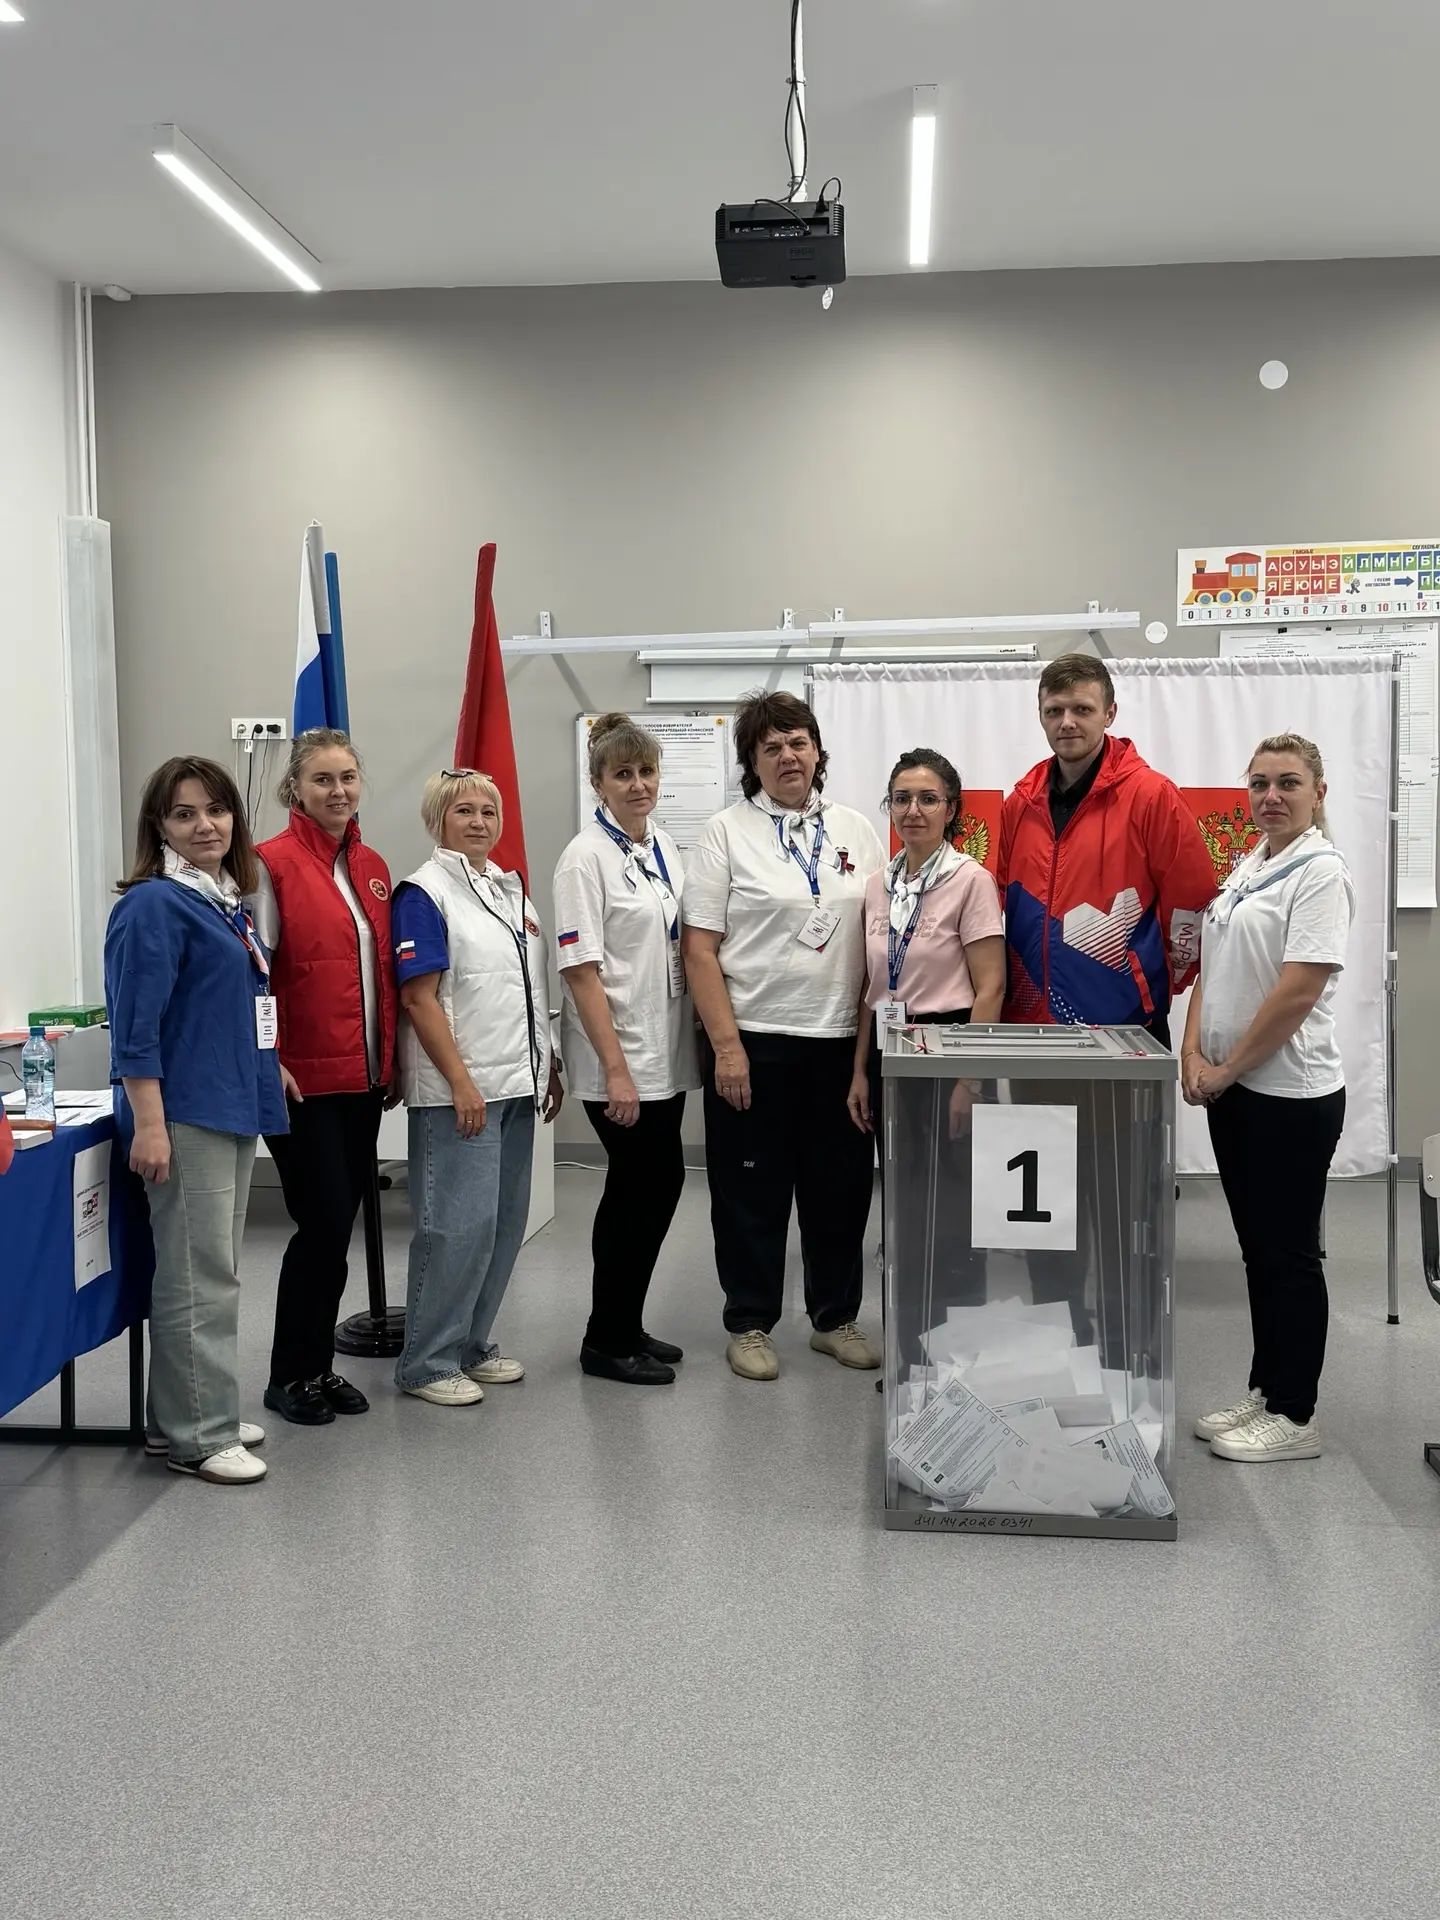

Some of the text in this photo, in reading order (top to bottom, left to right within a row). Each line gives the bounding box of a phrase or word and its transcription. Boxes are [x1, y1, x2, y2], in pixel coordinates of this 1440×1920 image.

[1267, 561, 1278, 572] А
[1282, 560, 1293, 571] О
[1298, 560, 1308, 570] У
[1312, 559, 1325, 570] Ы
[1328, 559, 1339, 569] Э
[1344, 556, 1354, 569] Й
[1359, 557, 1369, 568] Л
[1374, 557, 1385, 567] М
[1390, 556, 1400, 567] Н
[1405, 556, 1415, 566] Р
[1420, 555, 1431, 566] Б
[1267, 581, 1277, 592] Я
[1283, 578, 1292, 591] Ё
[1296, 580, 1309, 591] Ю
[1313, 580, 1323, 590] И
[1328, 579, 1338, 589] Е
[1420, 575, 1431, 586] П
[1188, 610, 1194, 619] 0
[1207, 610, 1212, 618] 1
[1226, 609, 1232, 618] 2
[1245, 608, 1251, 617] 3
[1264, 607, 1270, 616] 4
[1283, 607, 1290, 616] 5
[1302, 606, 1309, 615] 6
[1321, 605, 1328, 614] 7
[1341, 604, 1347, 613] 8
[1360, 604, 1367, 613] 9
[1377, 603, 1389, 612] 10
[1396, 602, 1407, 611] 11
[1416, 601, 1428, 611] 12
[1006, 1150, 1052, 1223] 1
[958, 1517, 997, 1528] 2026
